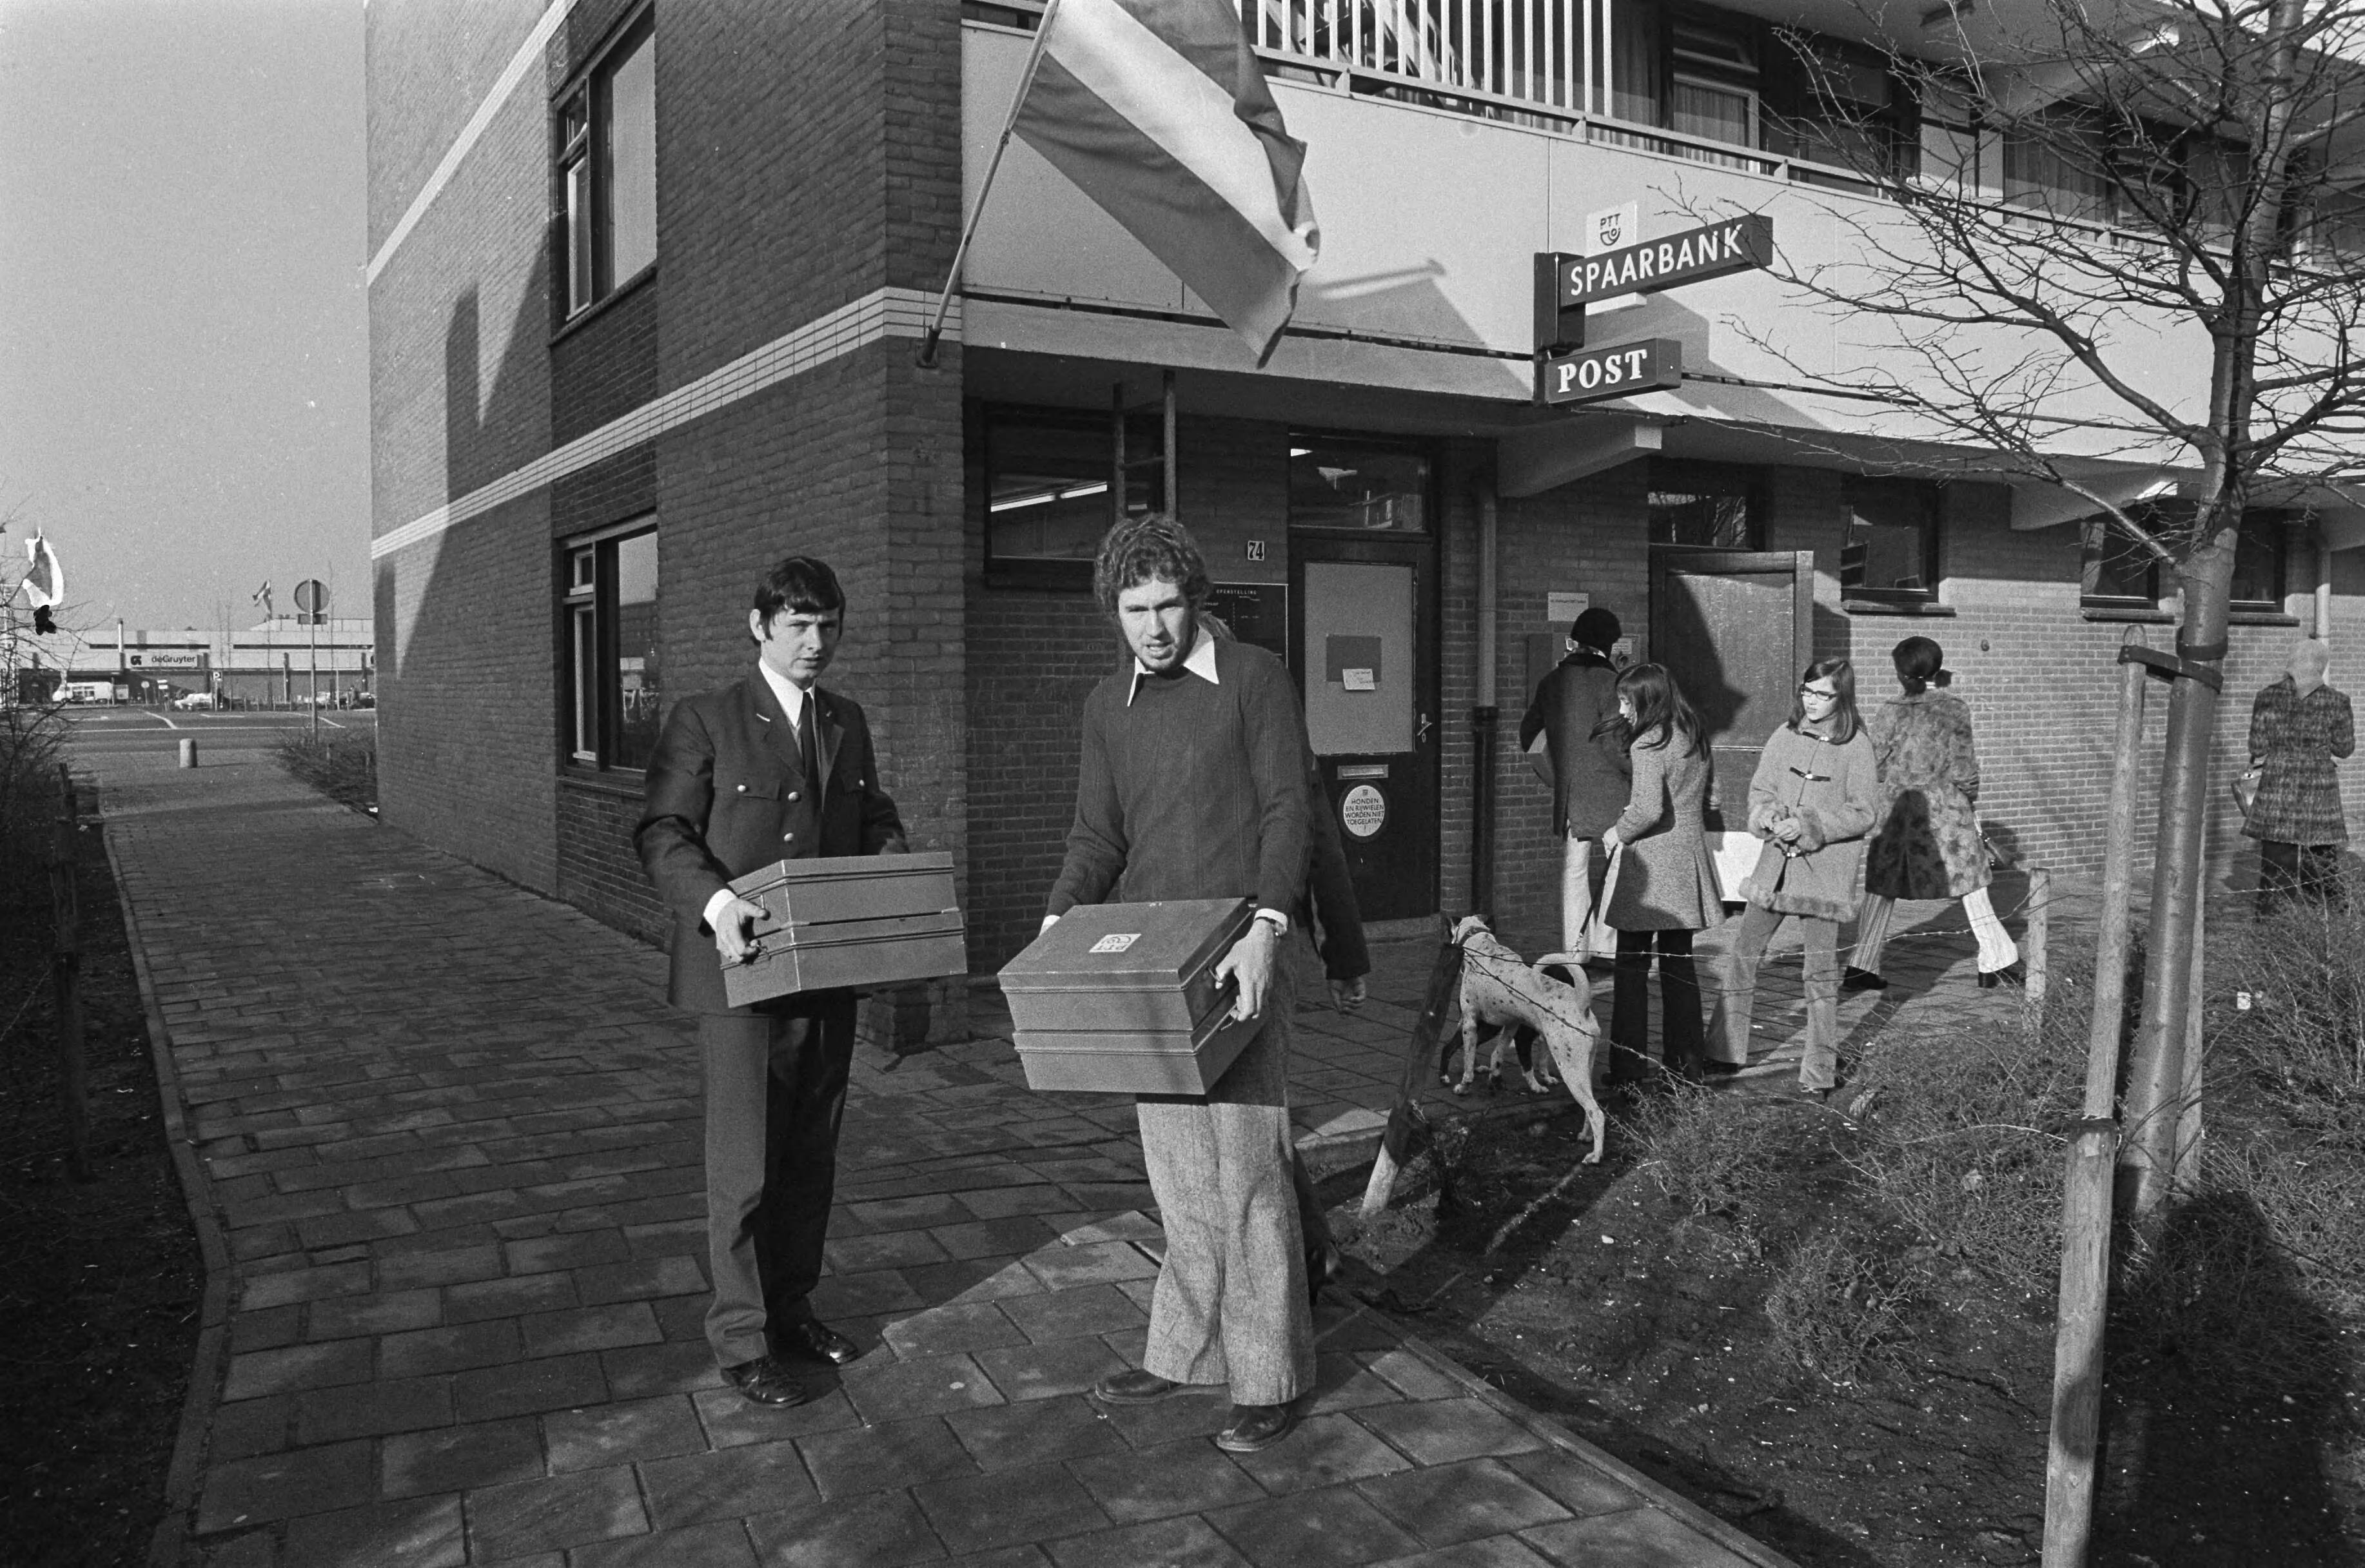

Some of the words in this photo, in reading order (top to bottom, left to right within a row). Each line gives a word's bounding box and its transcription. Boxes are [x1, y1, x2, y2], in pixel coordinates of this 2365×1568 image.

[1600, 213, 1621, 229] PTT
[1571, 224, 1743, 296] SPAARBANK
[1558, 349, 1647, 393] POST
[1249, 542, 1264, 560] 74
[213, 672, 221, 681] P
